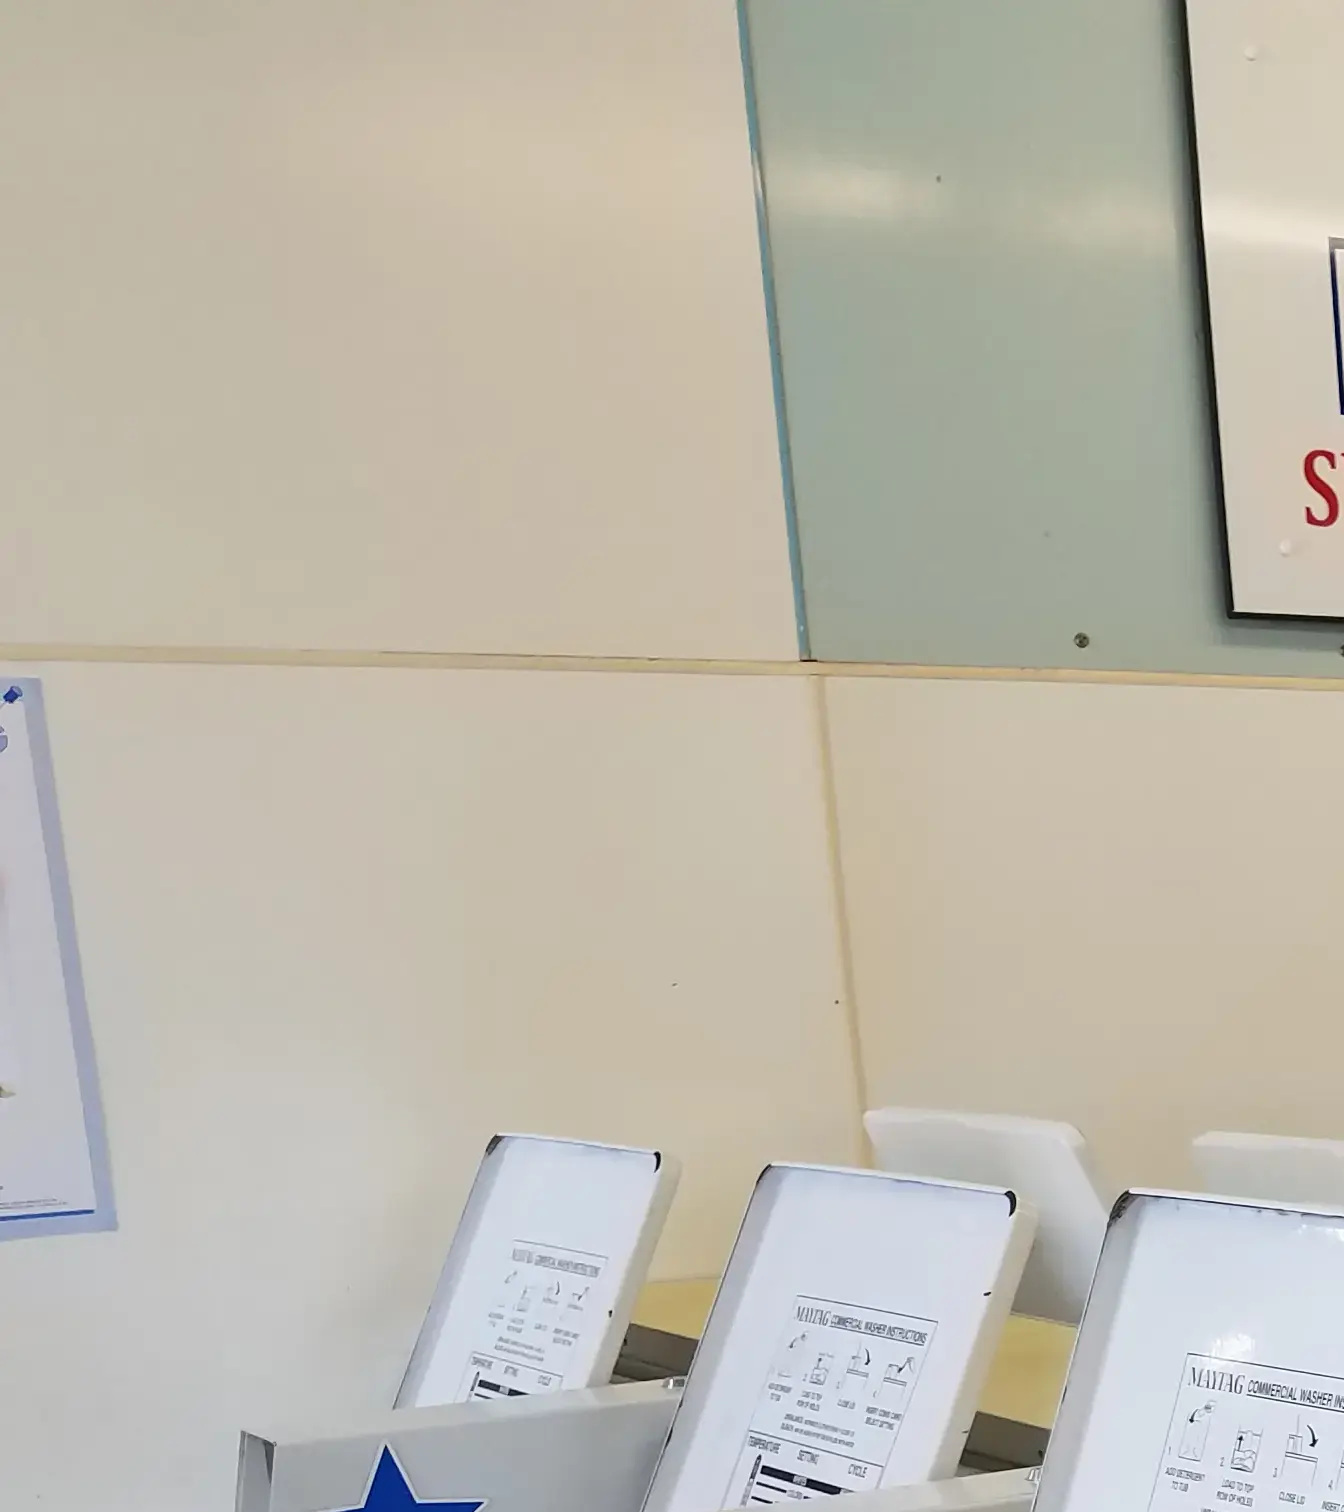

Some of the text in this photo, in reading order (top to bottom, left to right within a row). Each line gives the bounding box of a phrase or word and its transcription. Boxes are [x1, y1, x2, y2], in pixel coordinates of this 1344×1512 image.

[1188, 1366, 1245, 1394] MAYTAG
[1248, 1380, 1297, 1400] COMMERCIAL
[1300, 1388, 1334, 1406] WASHER
